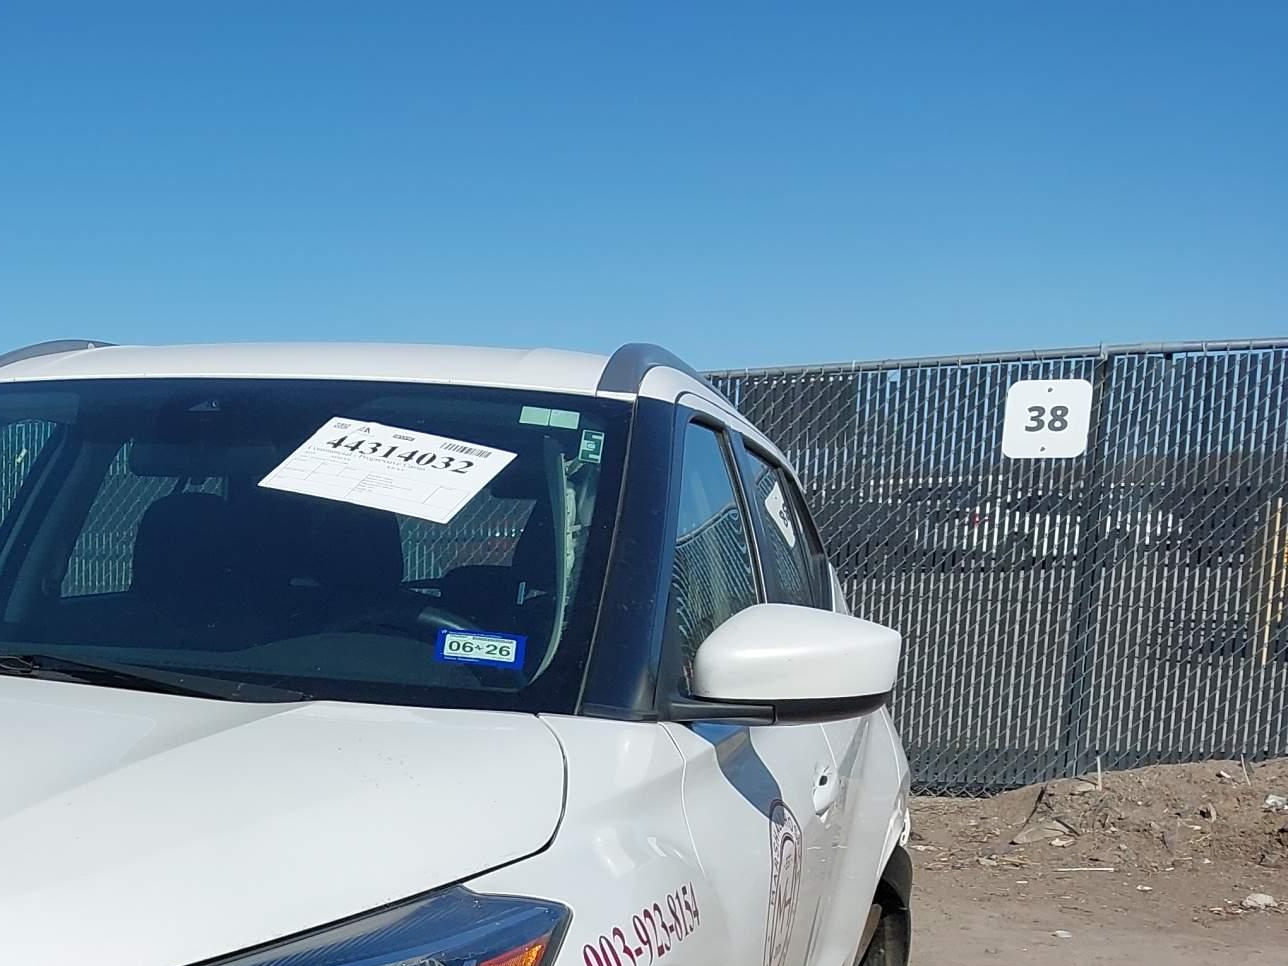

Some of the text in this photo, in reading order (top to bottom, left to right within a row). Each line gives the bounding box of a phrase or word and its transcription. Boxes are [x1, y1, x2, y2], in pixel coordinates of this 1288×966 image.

[1024, 405, 1069, 432] 38
[326, 435, 475, 474] 44314032
[448, 640, 511, 657] 06 26
